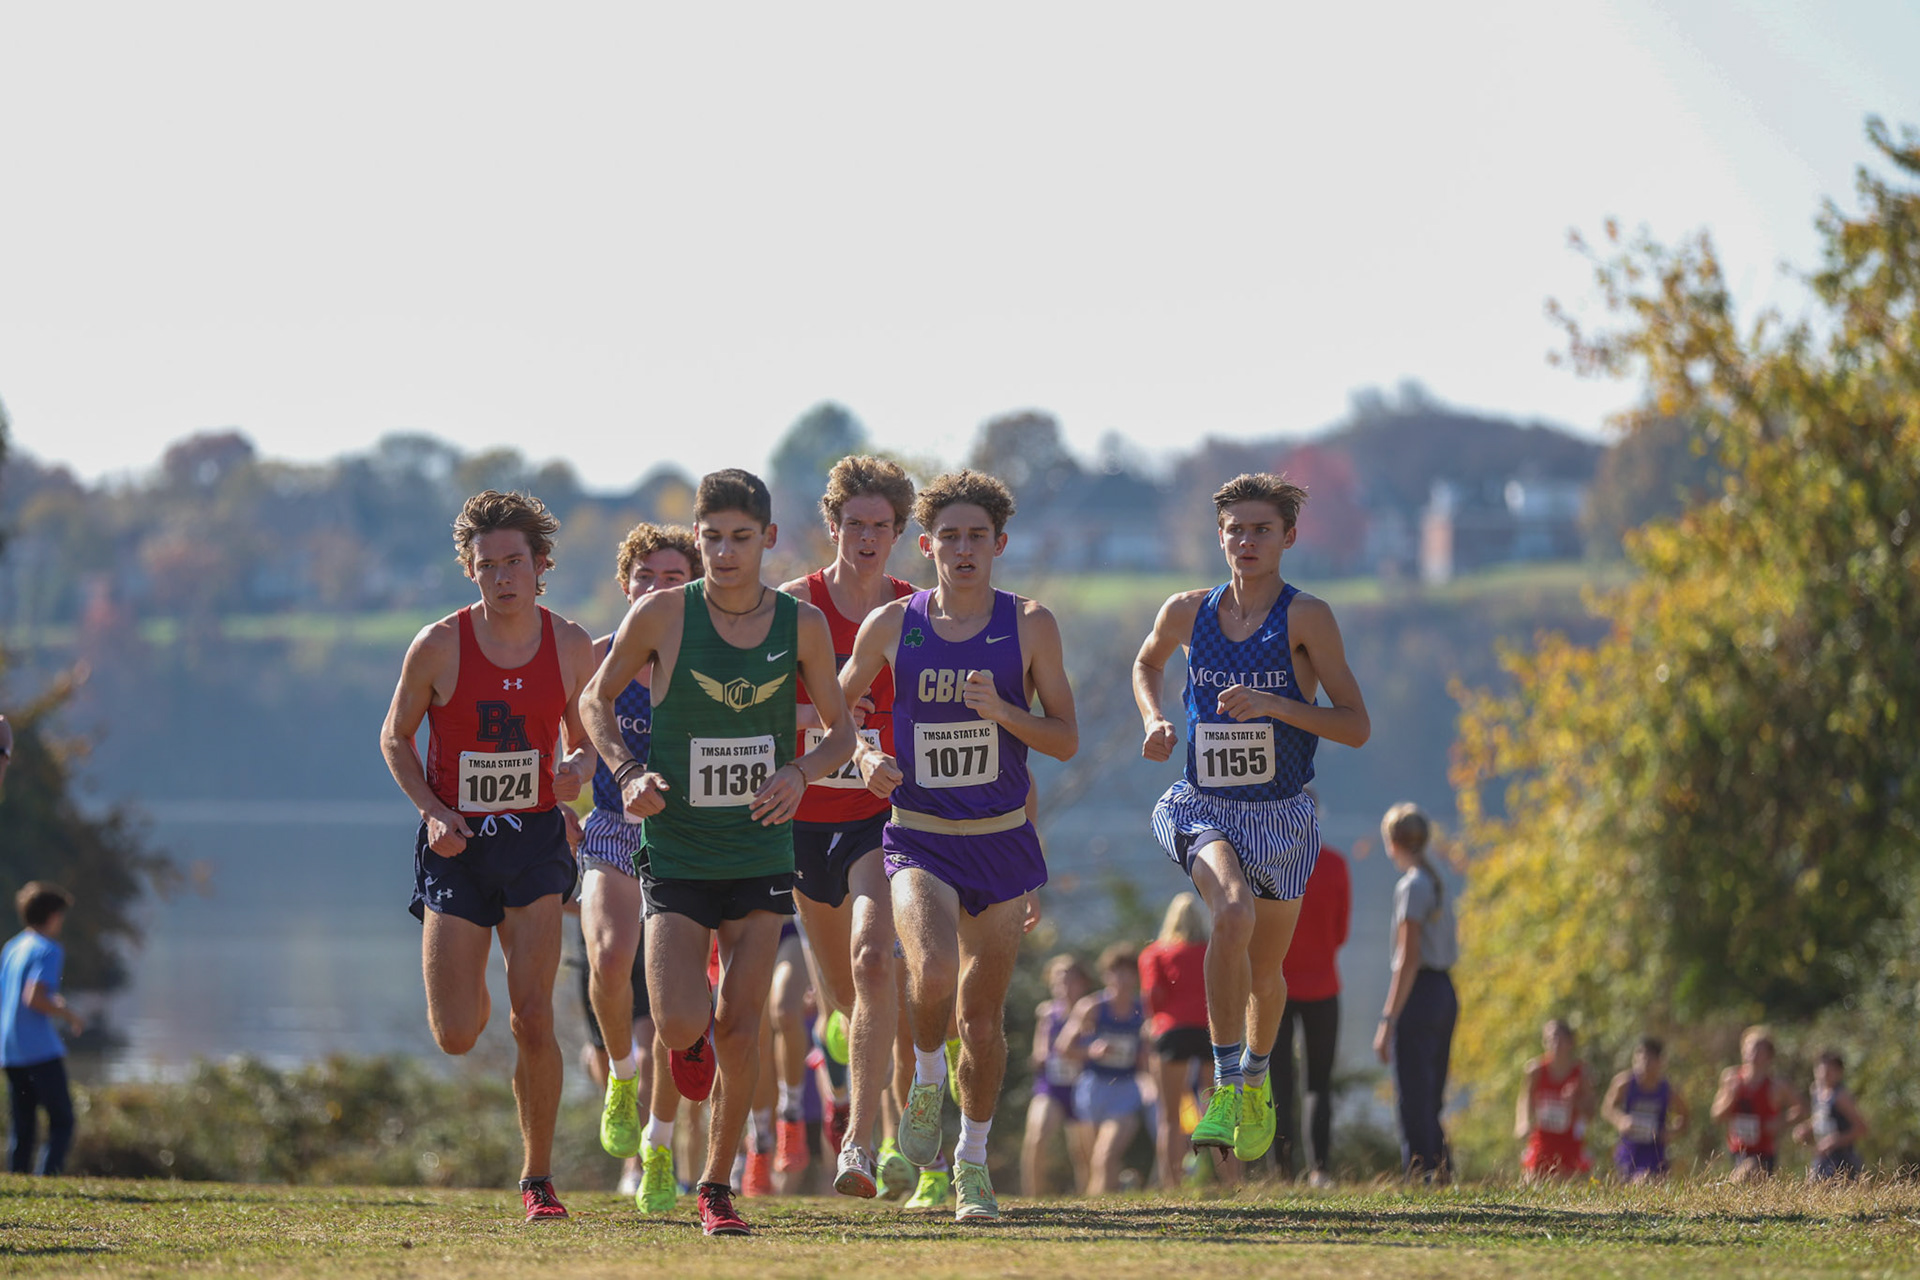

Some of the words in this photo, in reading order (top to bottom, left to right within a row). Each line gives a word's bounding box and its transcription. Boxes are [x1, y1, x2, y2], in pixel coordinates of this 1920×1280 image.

[918, 668, 994, 703] CBH
[922, 730, 952, 741] TMSAA
[953, 729, 978, 740] STATE
[979, 727, 991, 738] XC
[1204, 731, 1230, 741] TMSAA
[1231, 731, 1255, 740] STATE
[1255, 730, 1267, 740] XC
[468, 758, 497, 769] TMSAA
[498, 758, 521, 769] STATE
[522, 757, 533, 766] XC
[700, 747, 732, 757] TMSAA
[733, 745, 758, 756] STATE
[758, 744, 769, 755] XC
[925, 744, 988, 777] 1077
[1203, 747, 1267, 777] 1155
[466, 773, 532, 802] 1024
[699, 762, 768, 796] 1138
